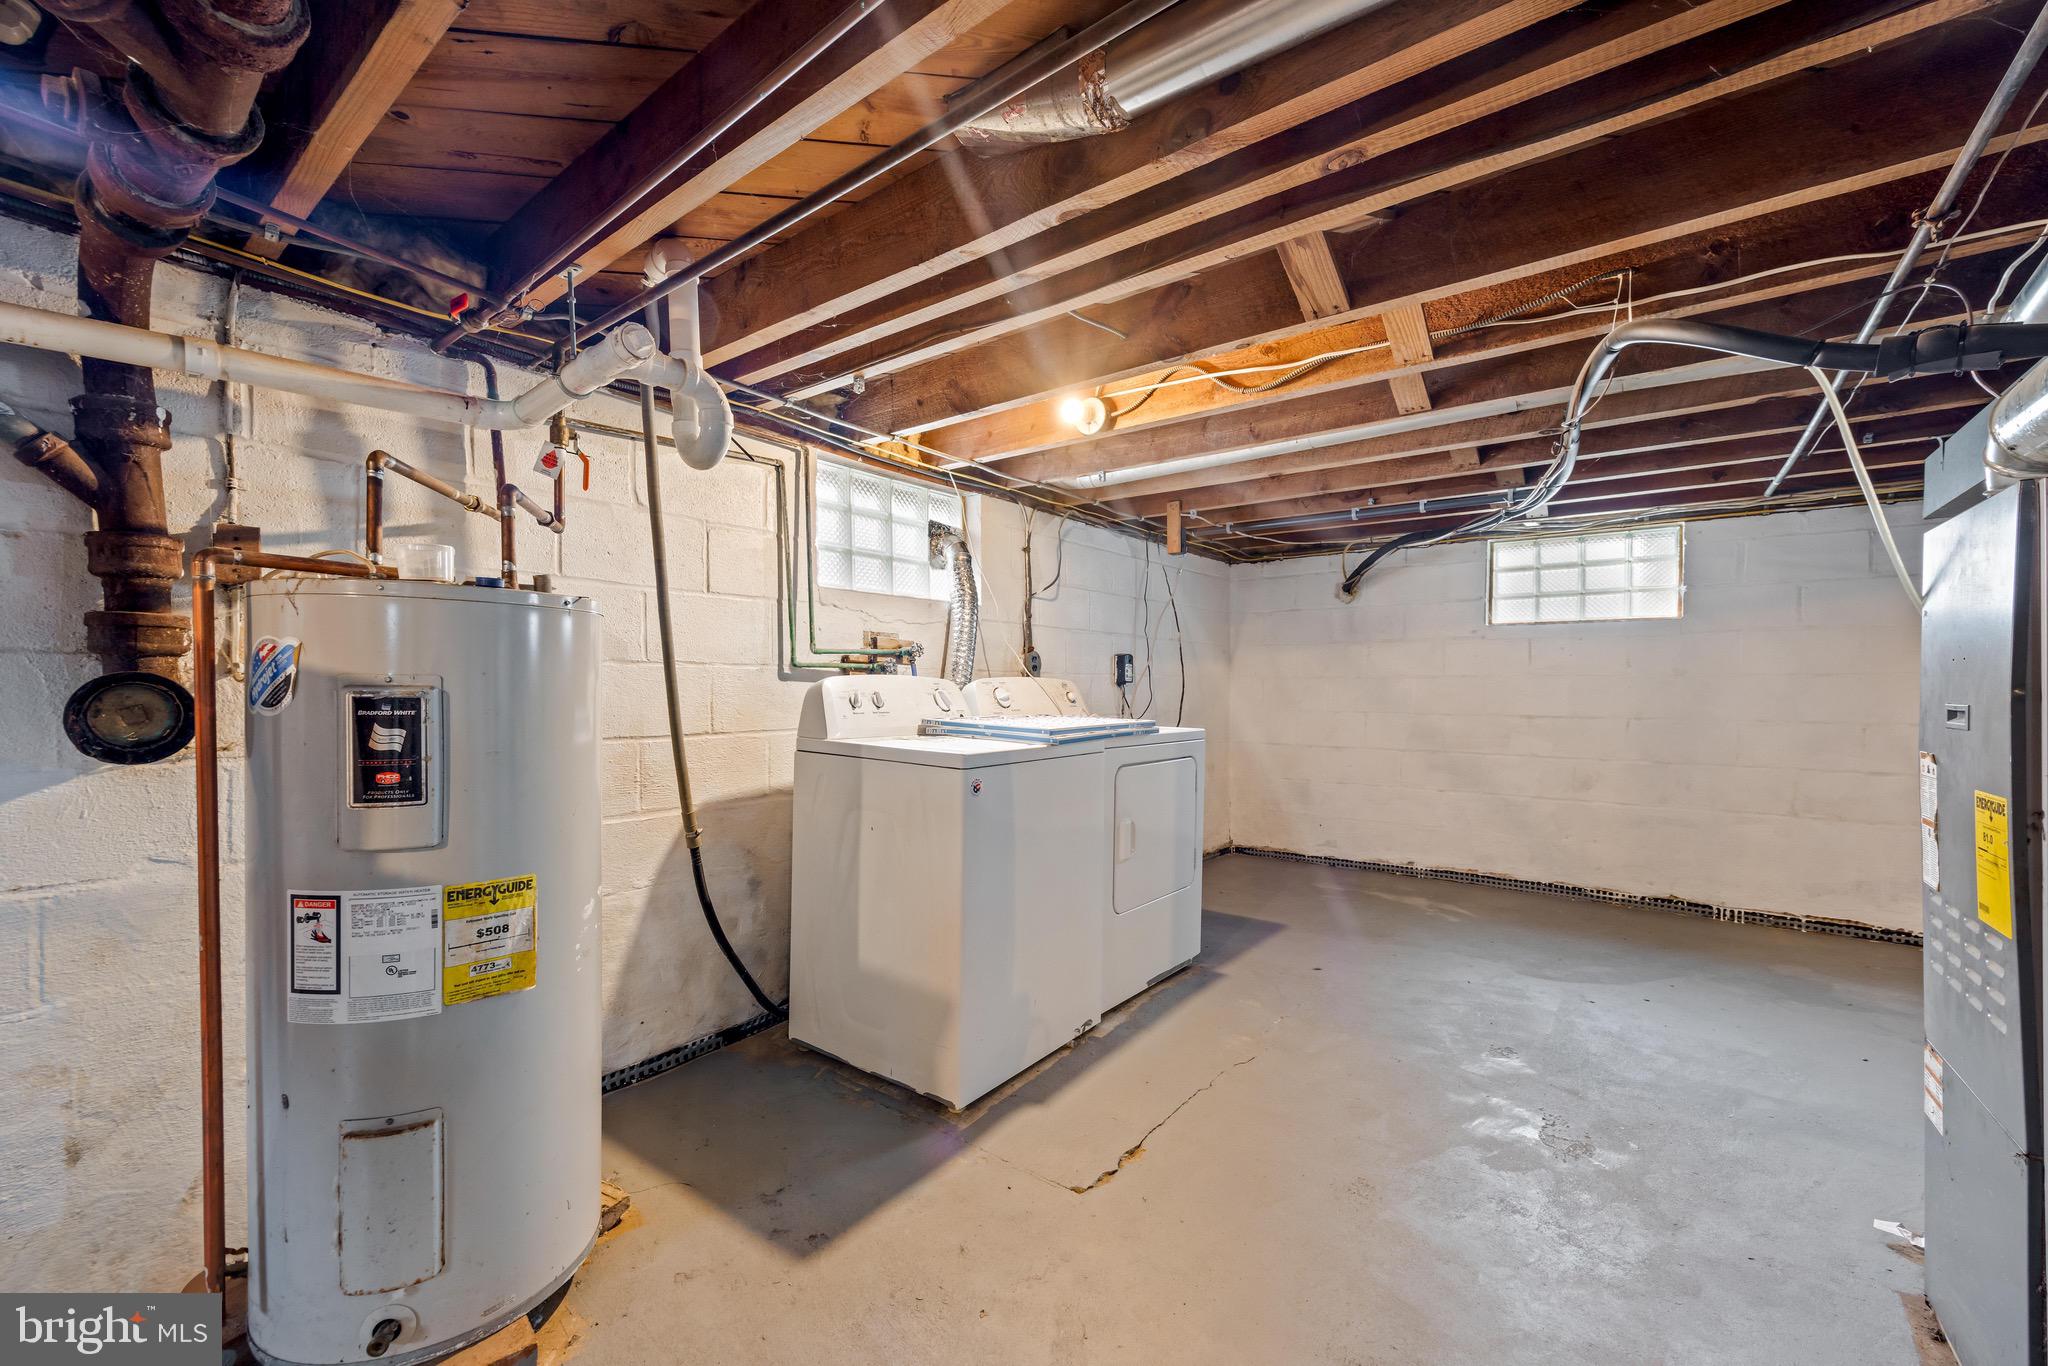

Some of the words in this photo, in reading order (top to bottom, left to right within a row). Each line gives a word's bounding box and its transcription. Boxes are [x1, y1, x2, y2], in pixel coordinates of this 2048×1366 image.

[447, 879, 533, 904] ENERGYGUIDE
[476, 924, 510, 939] $508
[471, 962, 496, 973] 4773
